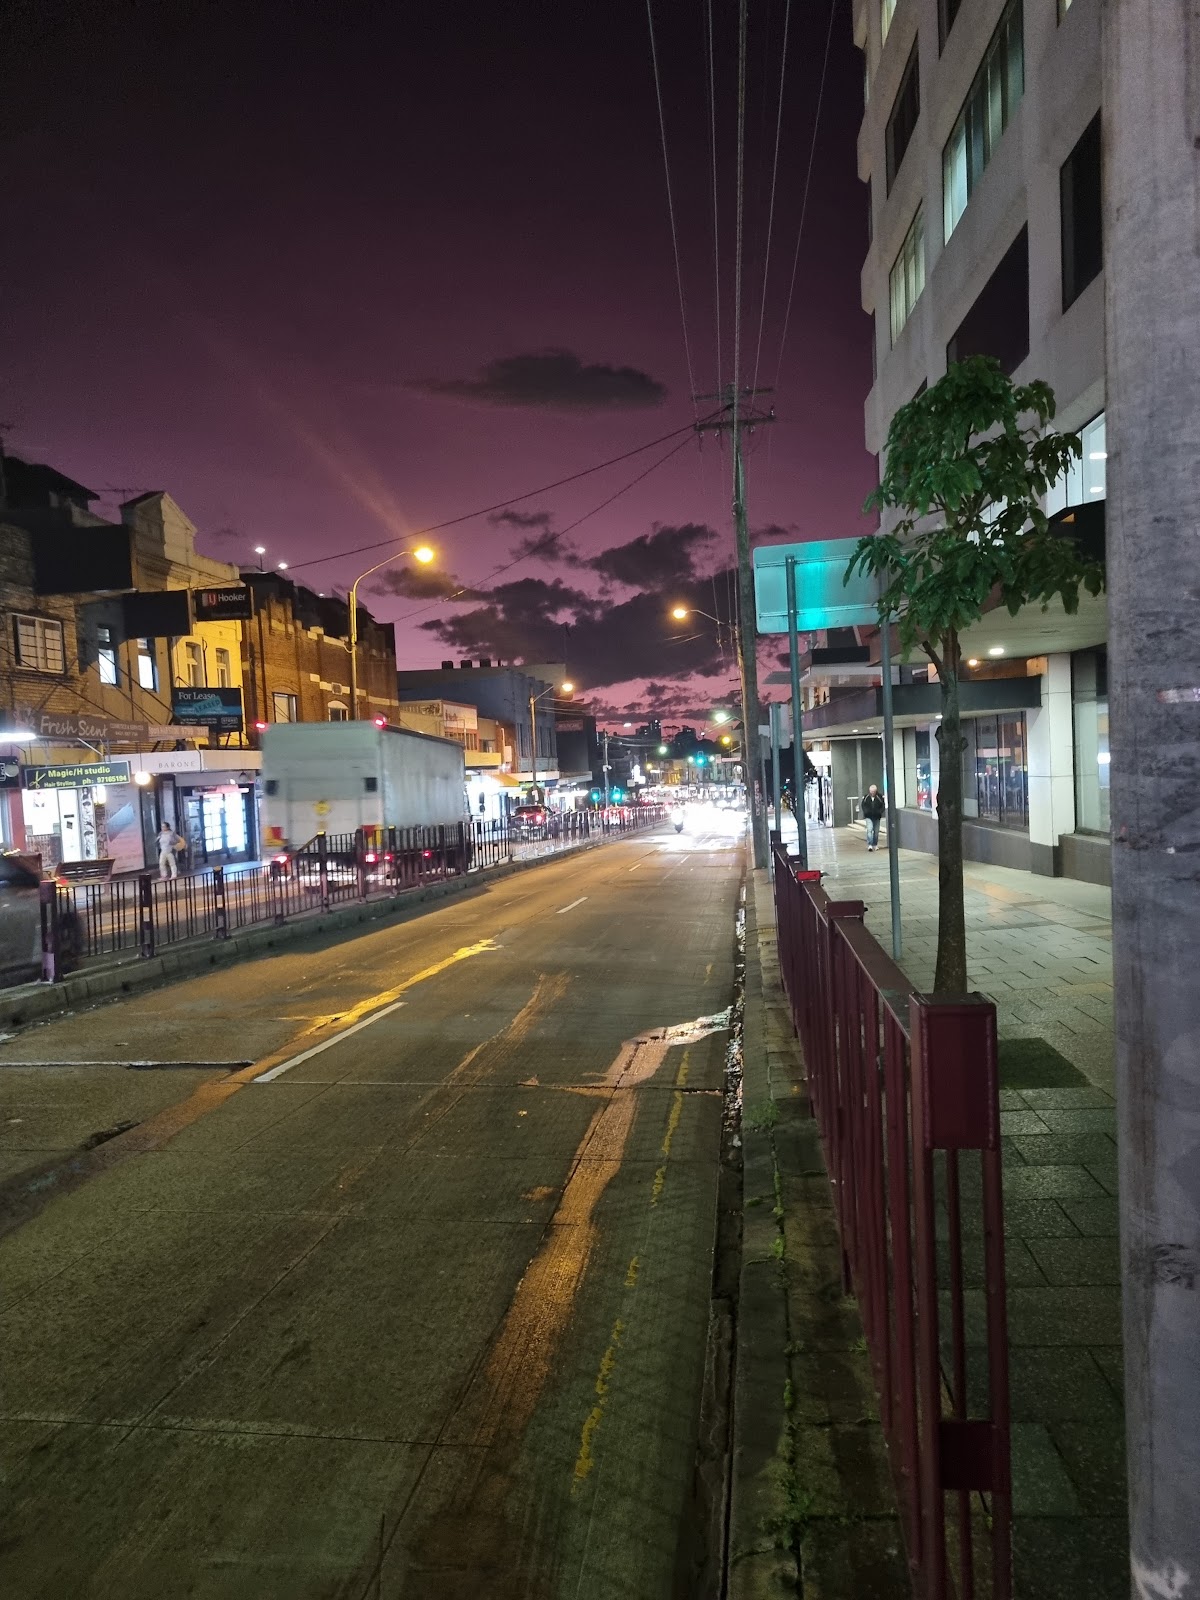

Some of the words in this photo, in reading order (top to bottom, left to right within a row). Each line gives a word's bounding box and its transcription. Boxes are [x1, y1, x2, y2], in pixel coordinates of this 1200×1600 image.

[218, 593, 246, 602] Hooker
[178, 692, 191, 700] For
[193, 692, 216, 700] Lease
[40, 715, 77, 735] Fresh
[78, 719, 108, 737] Scent
[158, 761, 195, 769] BARONE
[48, 767, 83, 778] Magic/H
[85, 766, 110, 775] studio
